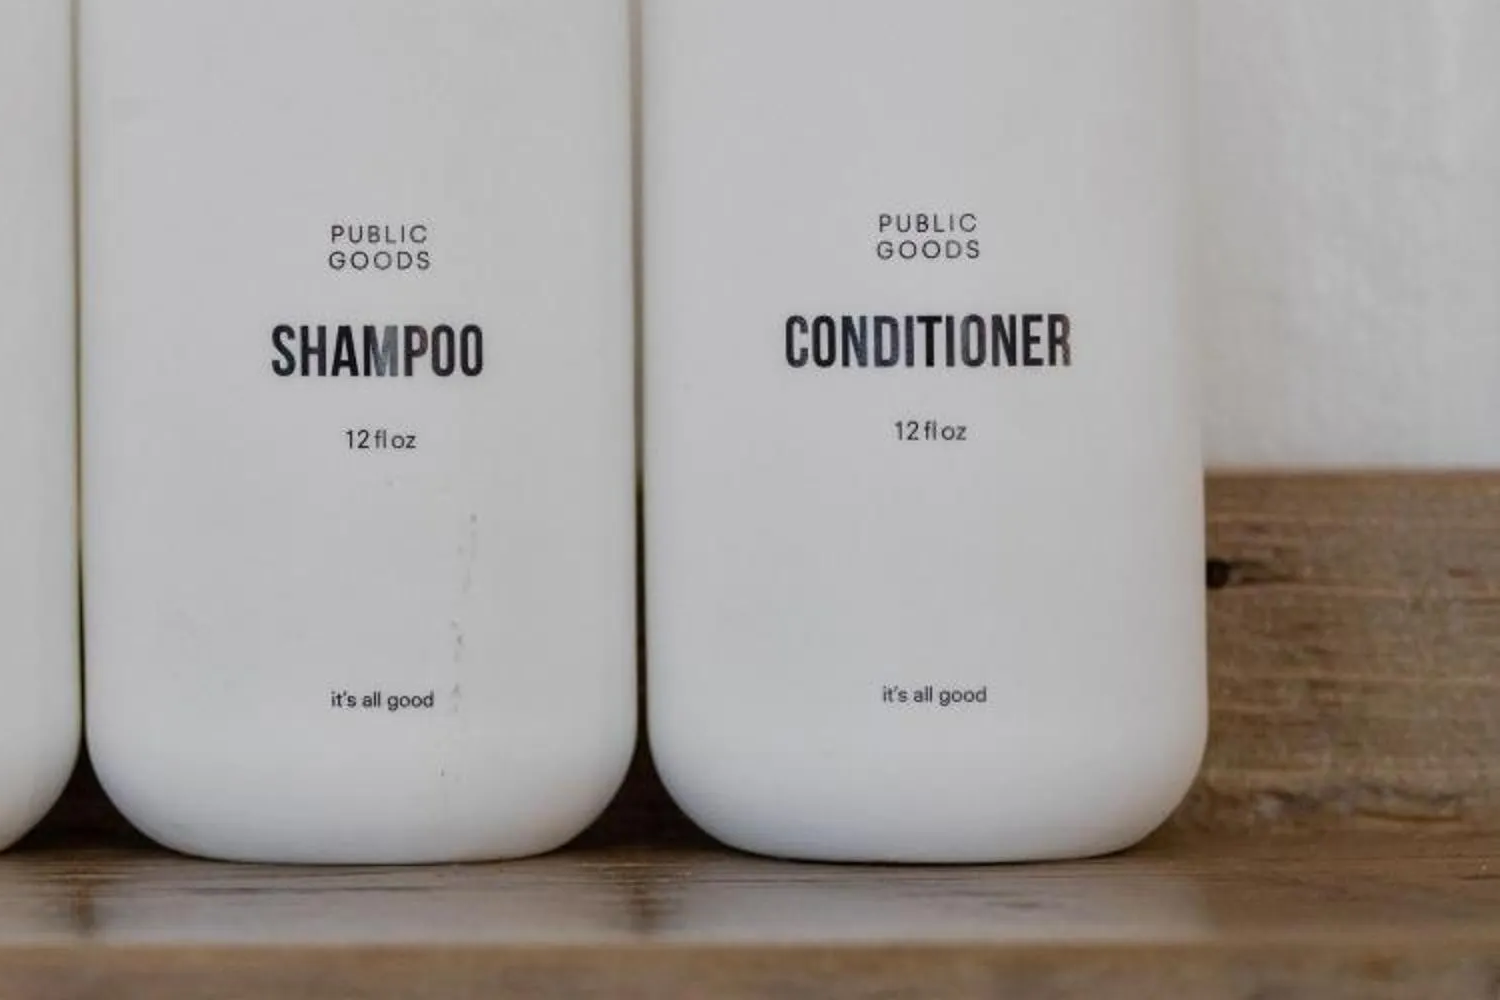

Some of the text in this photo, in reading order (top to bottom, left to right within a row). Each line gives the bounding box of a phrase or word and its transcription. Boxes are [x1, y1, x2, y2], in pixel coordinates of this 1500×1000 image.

[878, 213, 978, 233] PUBLIC
[330, 224, 428, 244] PUBLIC
[328, 250, 431, 271] GOODS
[876, 239, 981, 261] GOODS
[271, 323, 484, 378] SHAMPOO
[785, 313, 1072, 369] CONDITIONER
[345, 429, 417, 450] 12 fl oz
[895, 420, 967, 441] 12 fl oz
[331, 690, 435, 712] it's all good
[882, 685, 987, 708] it's all good
